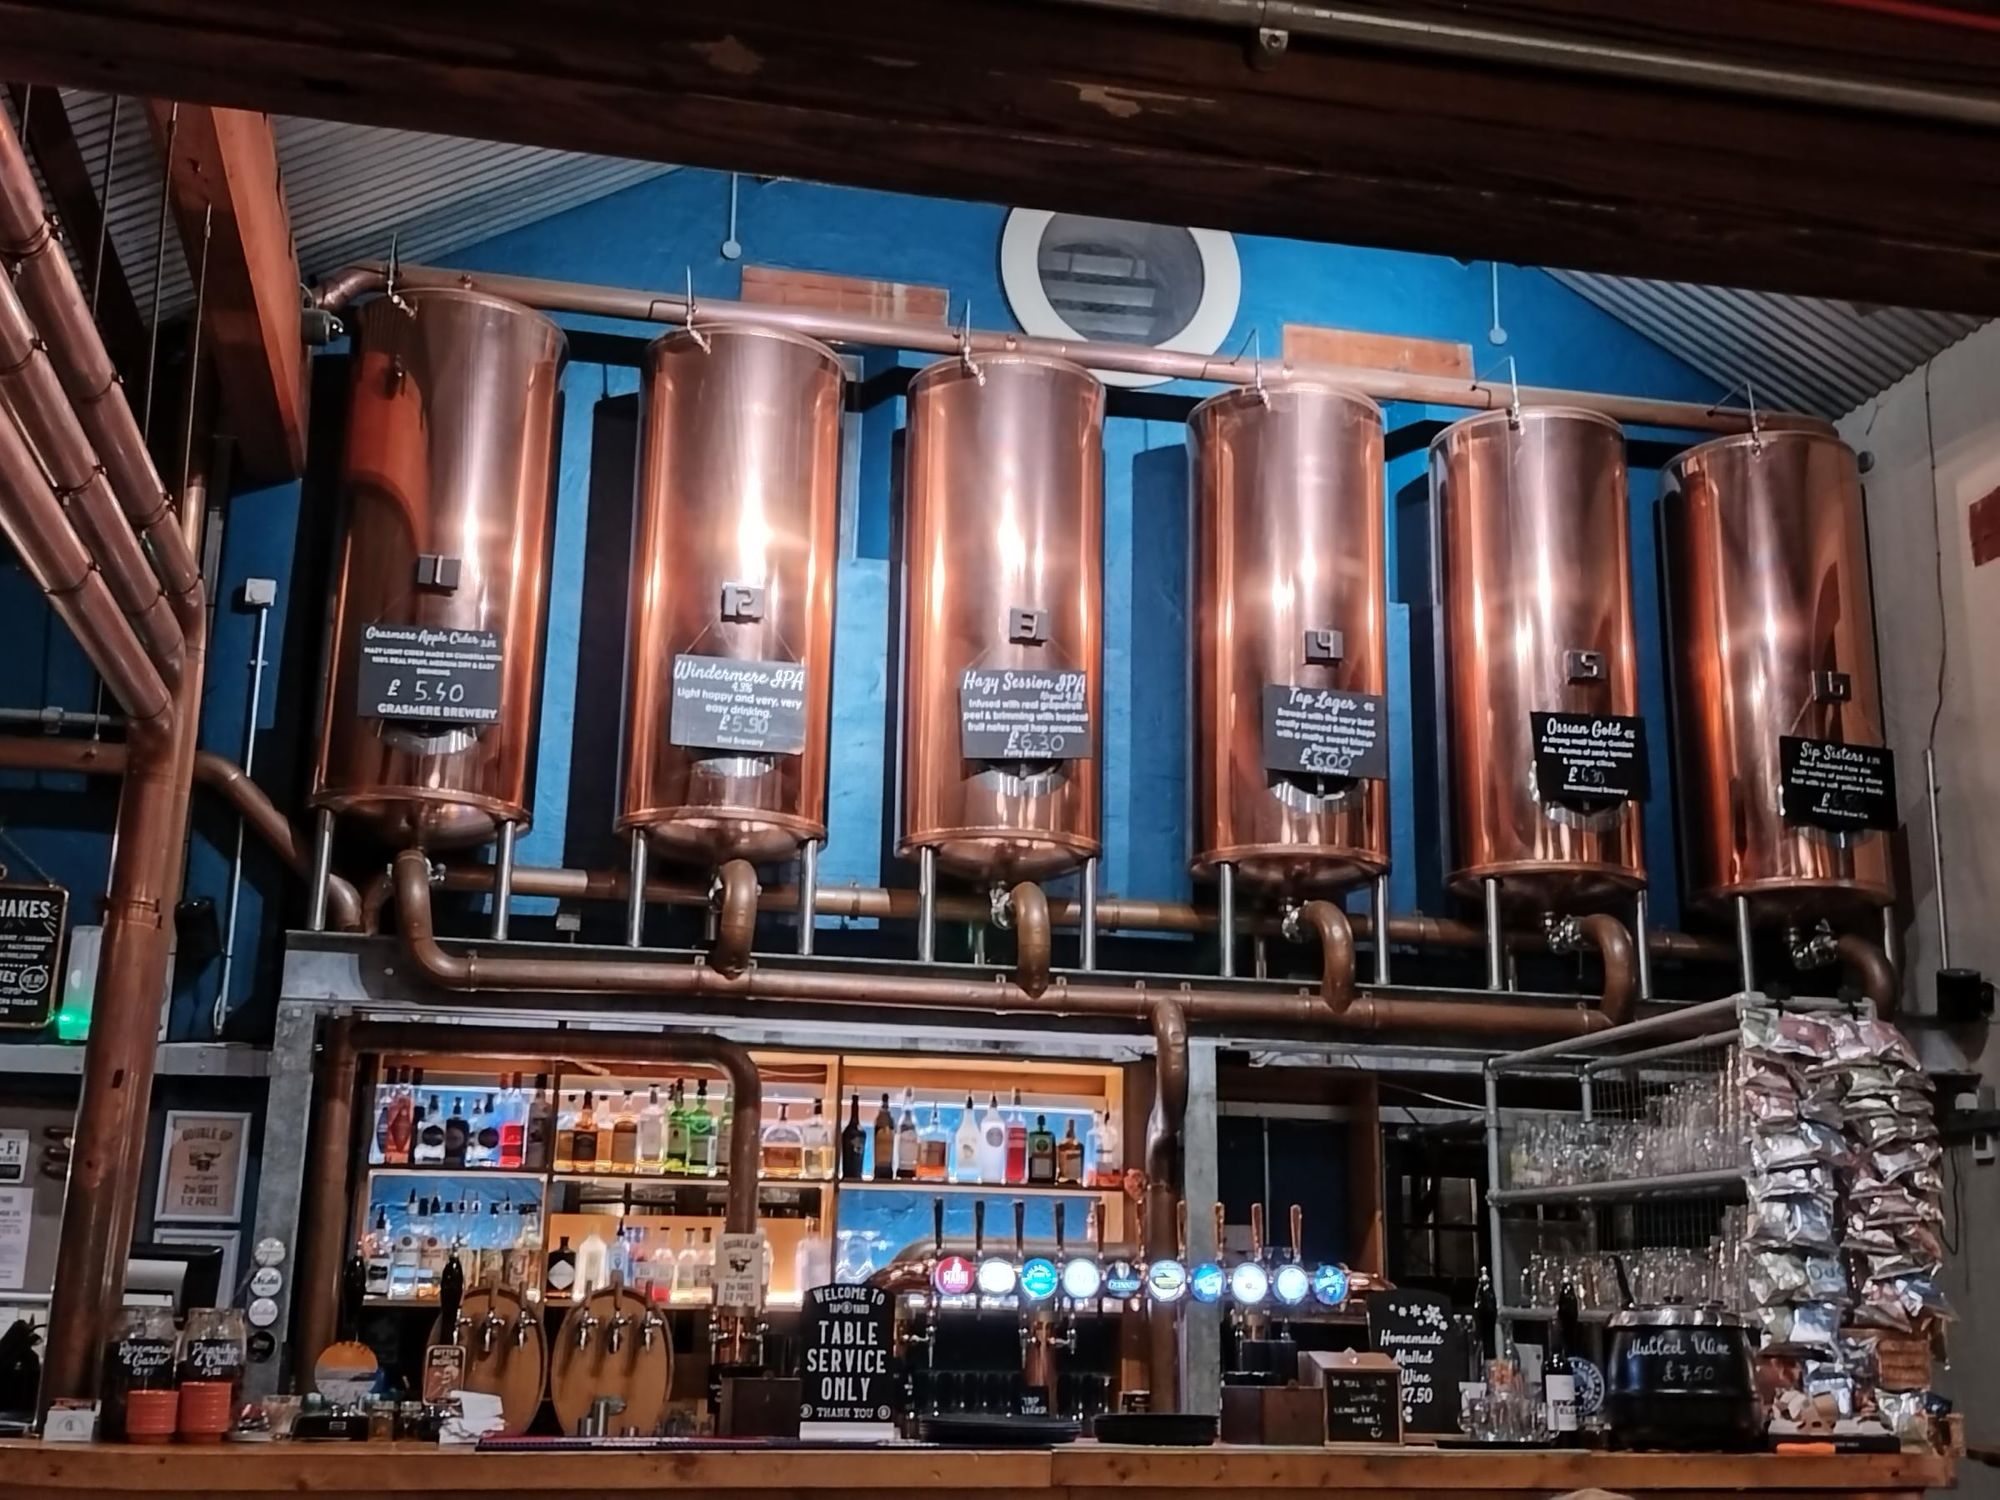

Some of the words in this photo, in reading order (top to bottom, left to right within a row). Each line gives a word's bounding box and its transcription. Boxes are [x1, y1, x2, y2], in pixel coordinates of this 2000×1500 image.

[735, 589, 754, 616] 2
[366, 627, 417, 641] Grasmere
[418, 629, 447, 647] Apple
[450, 633, 479, 644] Cider
[674, 660, 769, 684] Windermere
[770, 670, 804, 691] IPA
[963, 671, 999, 694] Hazy
[1002, 672, 1054, 691] Session
[1055, 674, 1085, 694] IPA
[677, 687, 700, 699] Light
[702, 688, 733, 703] hoppy
[735, 693, 754, 703] and
[781, 699, 801, 710] very
[1002, 700, 1020, 709] with
[1290, 687, 1314, 710] Tap
[1315, 691, 1357, 715] Lager
[378, 703, 441, 716] GRASMERE
[443, 707, 497, 719] BREWERY
[705, 704, 728, 715] easy
[730, 704, 772, 719] drinking.
[985, 711, 991, 719] &
[1036, 713, 1054, 721] with
[1325, 714, 1337, 722] the
[1339, 717, 1356, 725] very
[987, 723, 1010, 732] notes
[1012, 724, 1029, 732] and
[1031, 723, 1047, 733] hop
[1547, 717, 1589, 735] Ossian
[1592, 720, 1622, 738] Gold
[1800, 741, 1821, 761] Sip
[1823, 745, 1864, 762] Sisters
[813, 1287, 867, 1305] WELCOME
[870, 1288, 885, 1306] TO
[829, 1303, 841, 1314] TAP
[818, 1320, 878, 1346] TABLE
[1380, 1329, 1444, 1346] Homemade
[1627, 1339, 1686, 1359] Mulled
[1690, 1334, 1731, 1356] Wine
[807, 1348, 887, 1373] SERVICE
[1394, 1349, 1433, 1365] Mulled
[1401, 1368, 1431, 1385] Wine
[821, 1377, 871, 1402] ONLY
[816, 1406, 850, 1418] THANK
[853, 1408, 874, 1419] YOU
